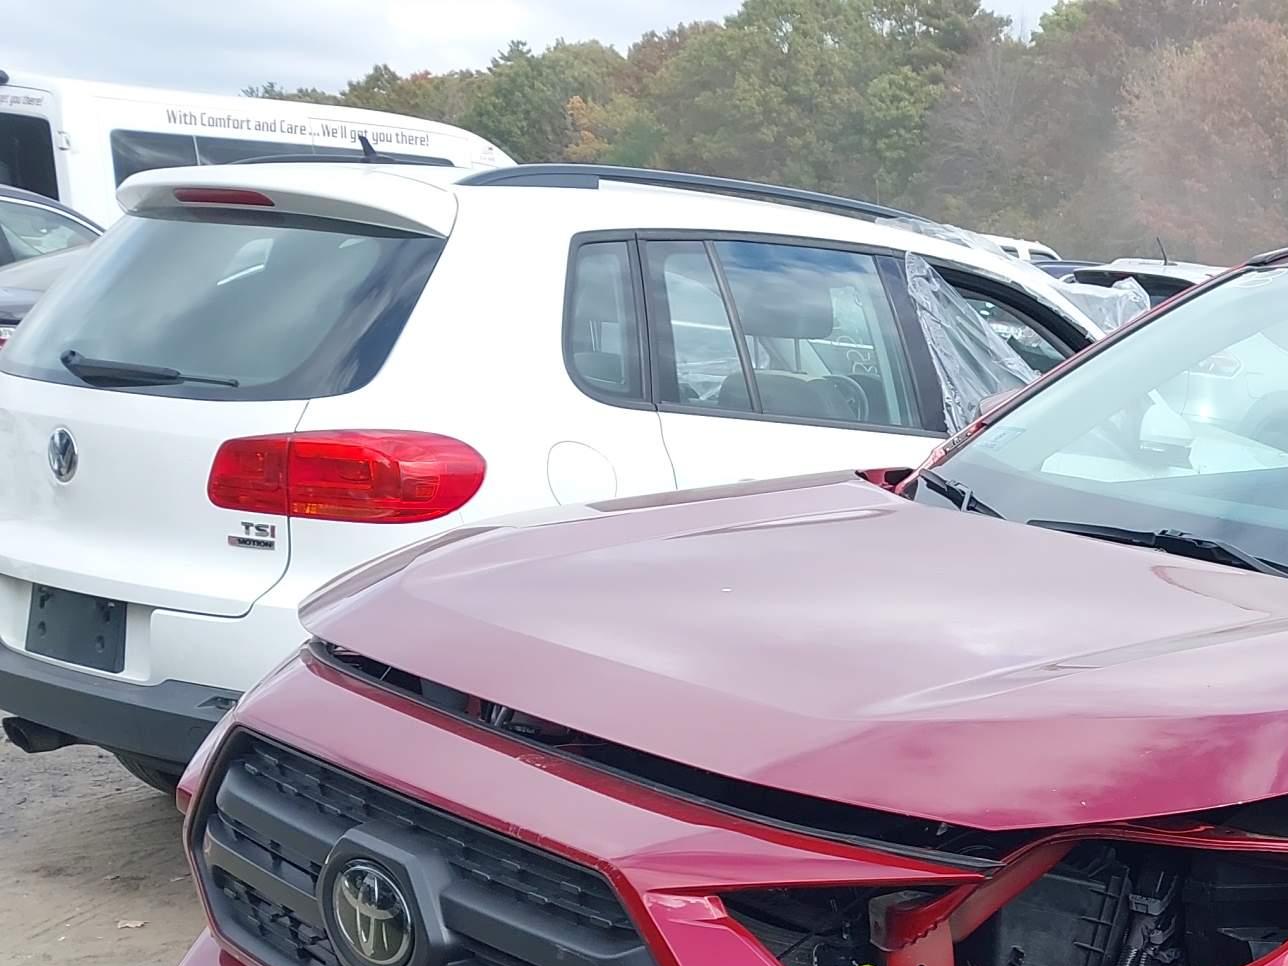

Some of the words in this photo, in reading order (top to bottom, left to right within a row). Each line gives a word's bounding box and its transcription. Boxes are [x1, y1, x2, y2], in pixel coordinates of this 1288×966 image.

[166, 108, 197, 126] With
[200, 112, 251, 131] Comfort
[254, 119, 277, 133] and
[350, 128, 368, 144] get
[371, 131, 393, 145] you
[395, 132, 429, 147] there!
[241, 521, 276, 539] TSI
